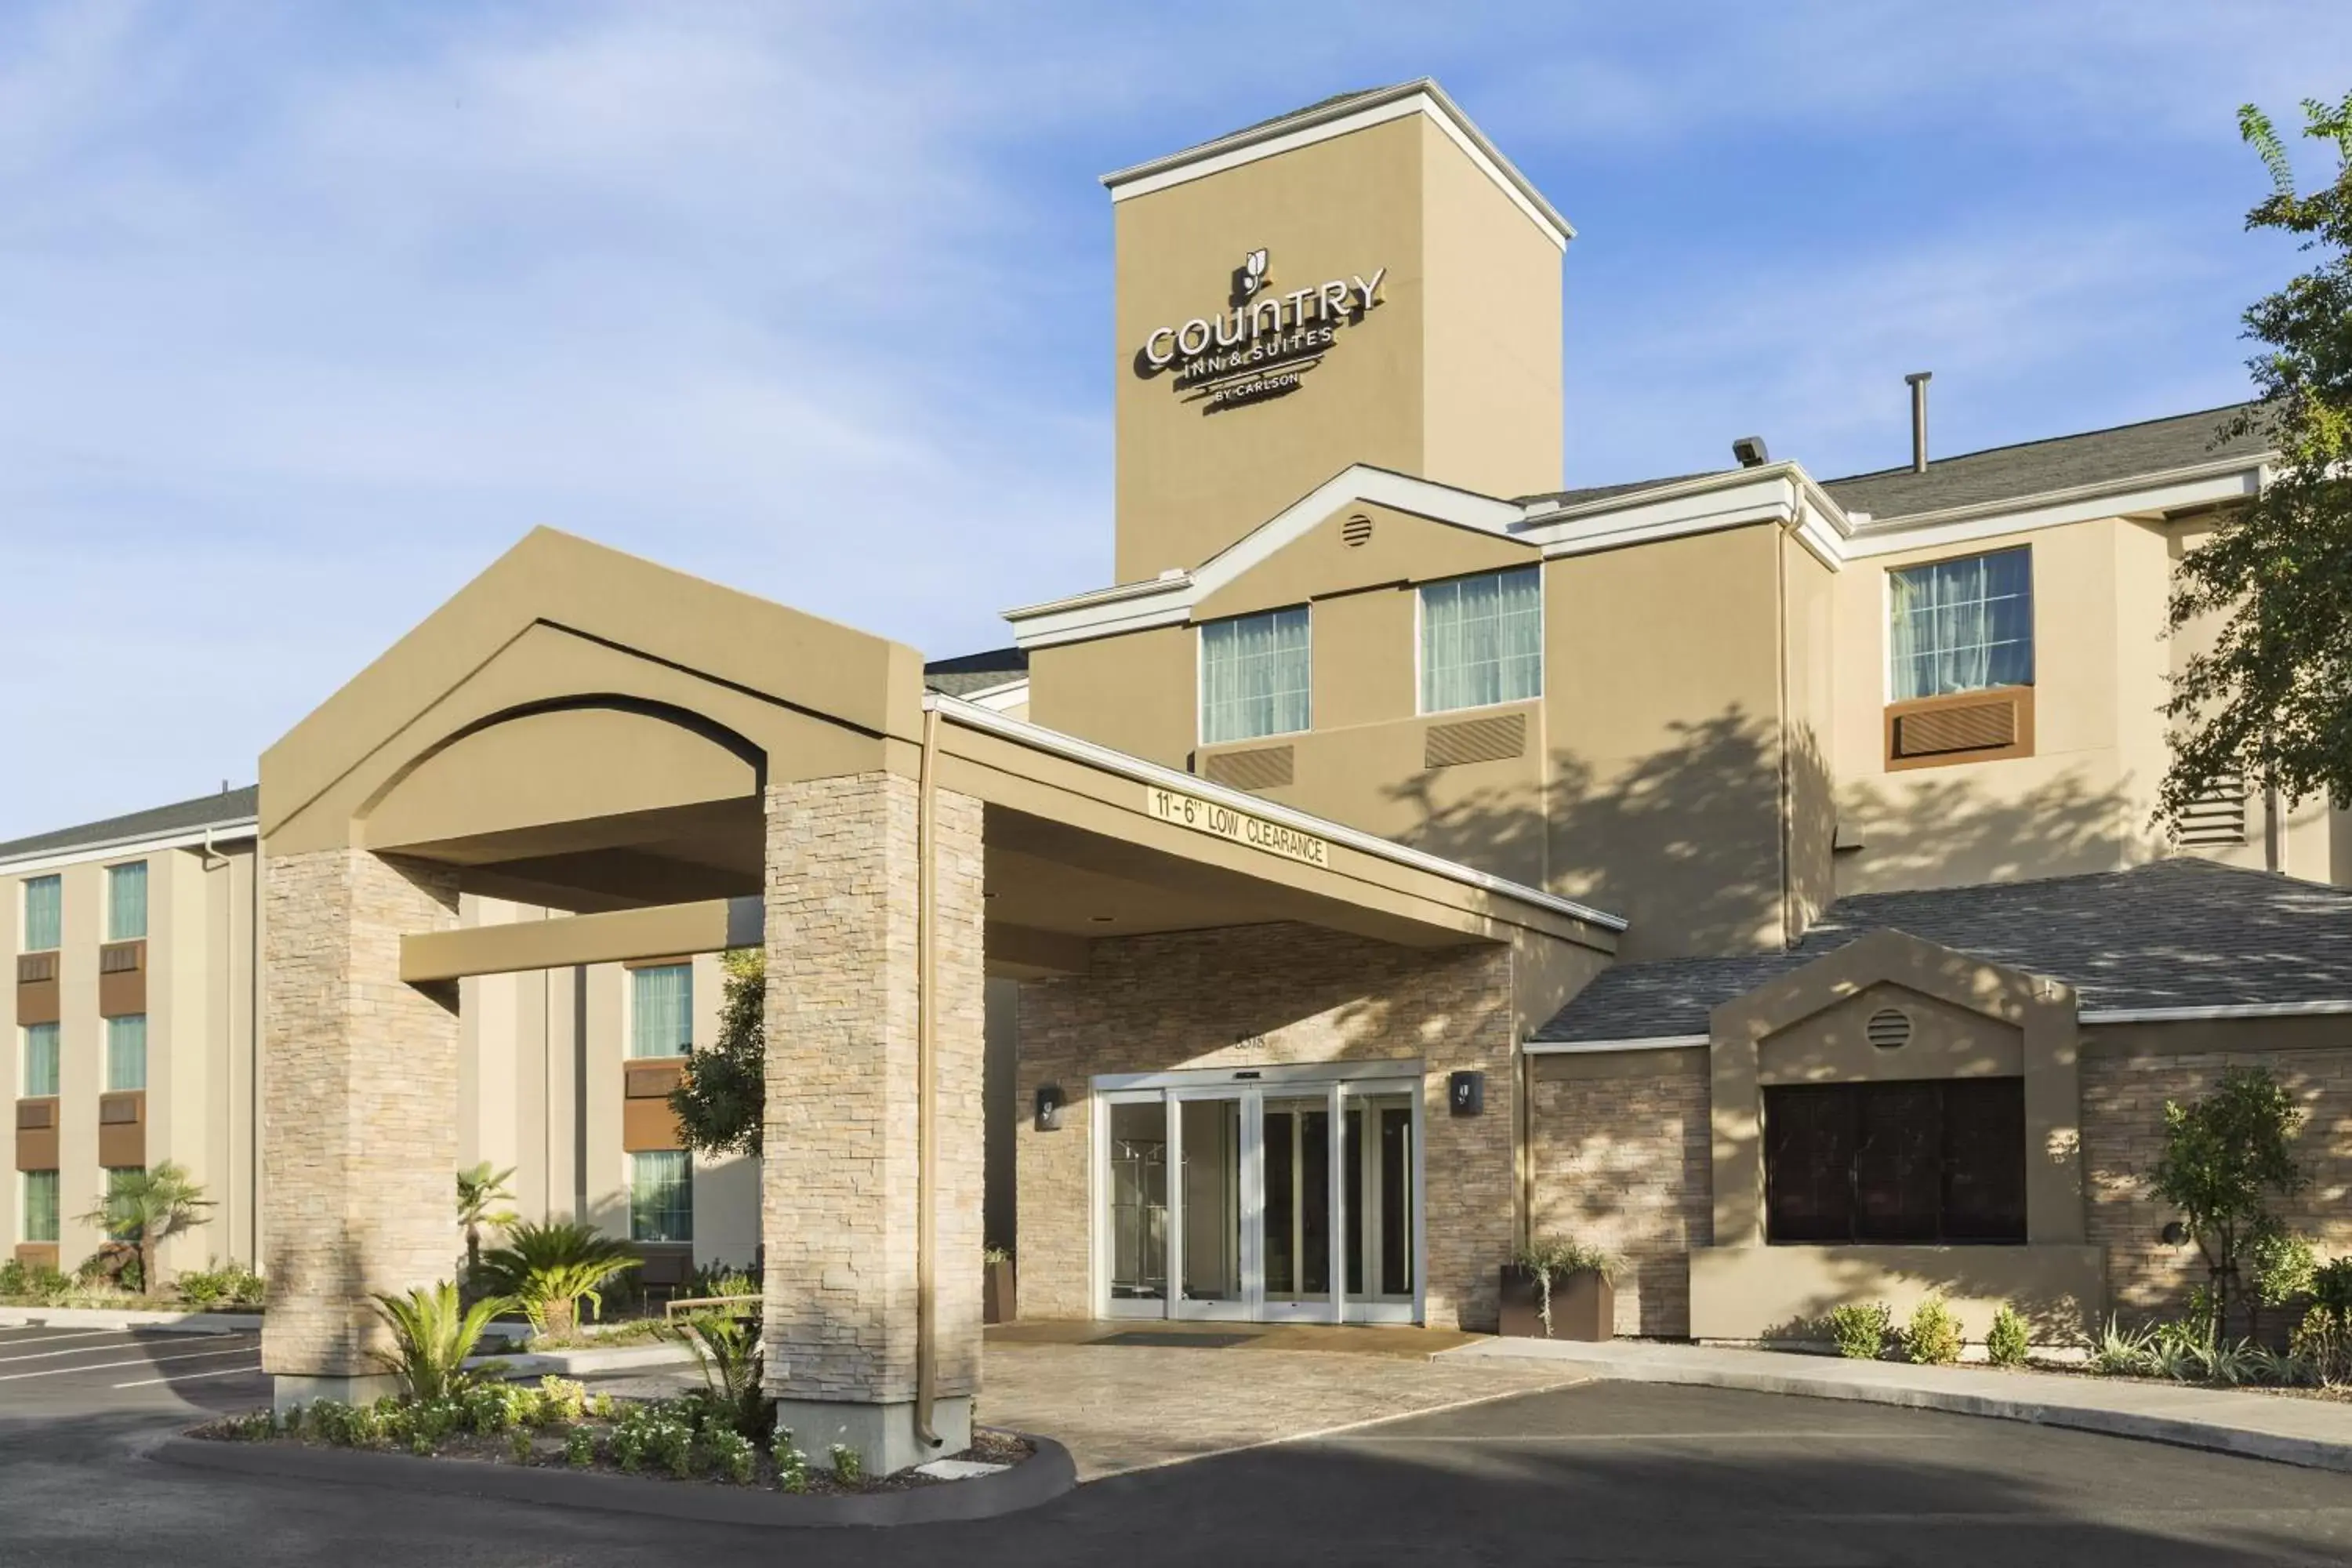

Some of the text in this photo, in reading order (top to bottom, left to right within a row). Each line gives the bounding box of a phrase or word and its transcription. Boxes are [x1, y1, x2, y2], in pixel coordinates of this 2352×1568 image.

[1185, 327, 1332, 378] INN & SUITES
[1216, 372, 1298, 401] BY CARLSON
[1208, 805, 1239, 837] LOW
[1247, 818, 1323, 863] CLEARANCE
